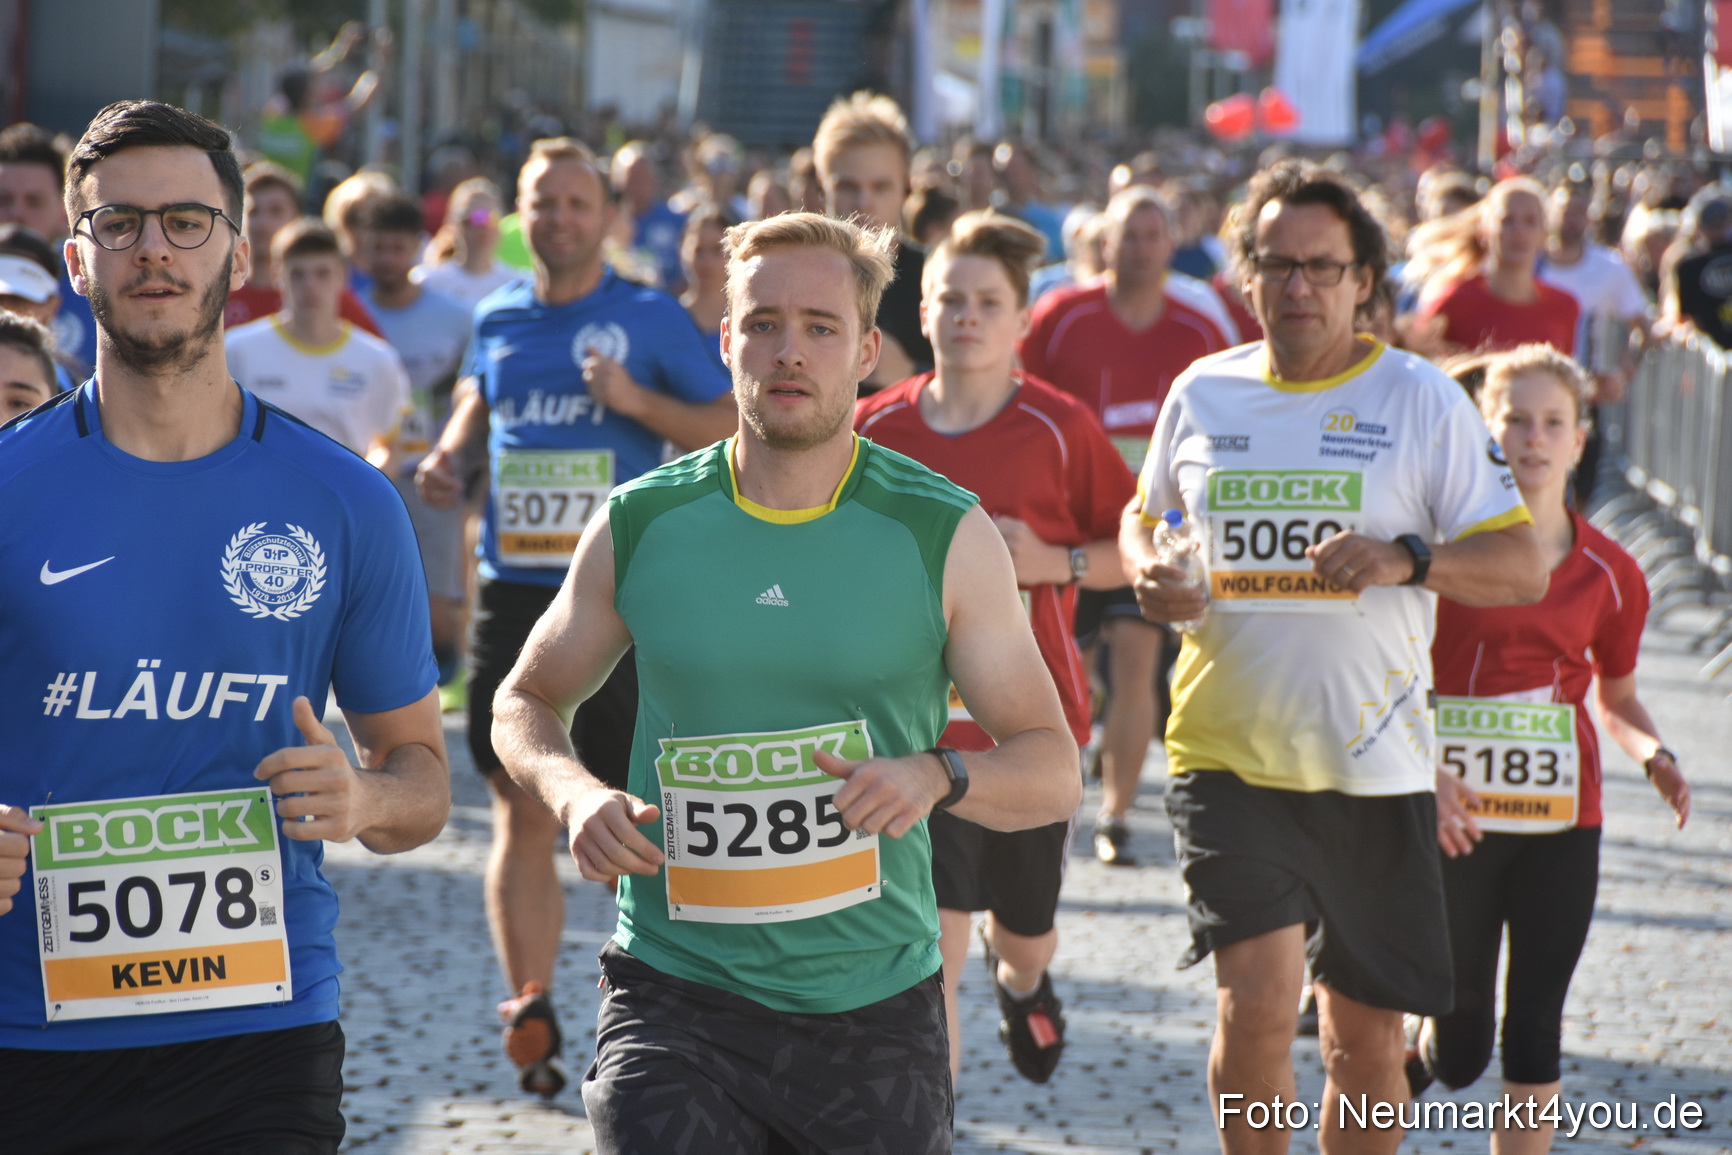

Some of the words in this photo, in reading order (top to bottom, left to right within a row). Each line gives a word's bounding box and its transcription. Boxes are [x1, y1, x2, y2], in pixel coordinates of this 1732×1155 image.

[499, 389, 606, 426] LÄUFT
[1324, 414, 1355, 431] 20
[1319, 446, 1377, 462] Stadtlauf
[1321, 434, 1393, 449] Neumarkter
[1218, 475, 1346, 504] BOCK
[506, 491, 596, 526] 5077
[243, 536, 306, 564] Blitzschutztechnik
[236, 562, 313, 578] J.PRÖPSTER
[264, 575, 284, 588] 40
[251, 588, 269, 601] 1979
[276, 591, 296, 602] 2019
[755, 597, 789, 607] adidas
[43, 659, 288, 722] #LÄUFT
[1440, 706, 1559, 737] BOCK
[673, 733, 846, 783] BOCK
[1442, 745, 1559, 787] 5183
[1465, 798, 1551, 817] ATHRIN
[52, 801, 257, 858] BOCK
[686, 794, 852, 858] 5285
[68, 867, 257, 943] 5078
[112, 955, 226, 990] KEVIN
